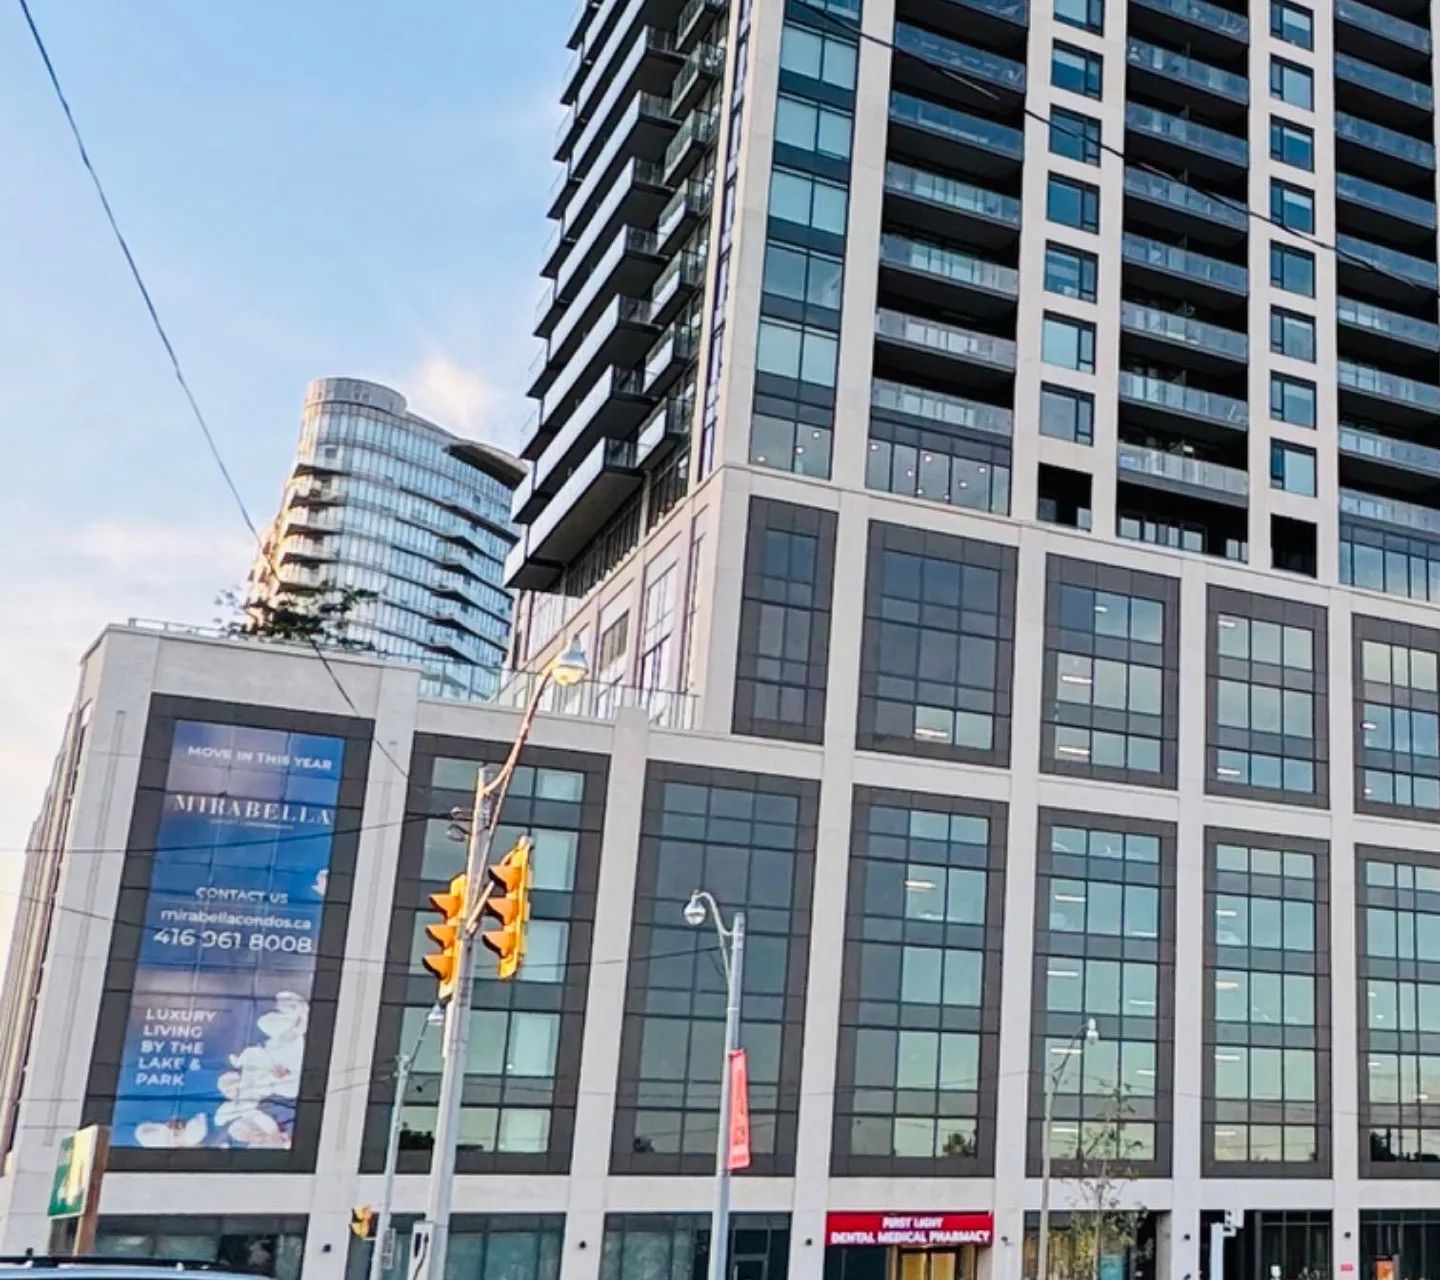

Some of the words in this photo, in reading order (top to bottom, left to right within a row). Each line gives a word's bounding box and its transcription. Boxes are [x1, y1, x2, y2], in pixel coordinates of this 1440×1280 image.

[188, 746, 231, 759] MOVE
[237, 750, 252, 760] IN
[258, 752, 289, 765] THIS
[294, 757, 332, 770] YEAR
[174, 794, 332, 825] MIRABELLA
[196, 887, 265, 904] CONTACT
[270, 893, 288, 905] US
[161, 908, 312, 931] mirabellacondos.ca
[153, 927, 196, 947] 416
[201, 930, 241, 950] 961
[249, 933, 312, 954] 8008
[146, 1008, 217, 1022] LUXURY
[143, 1024, 203, 1038] LIVING
[141, 1040, 165, 1054] BY
[170, 1041, 204, 1055] THE
[138, 1056, 185, 1070] LAKE
[189, 1058, 201, 1071] &
[135, 1072, 185, 1086] PARK
[830, 1231, 875, 1244] DENTAL
[878, 1231, 926, 1243] MEDICAL
[929, 1230, 990, 1243] PHARMACY
